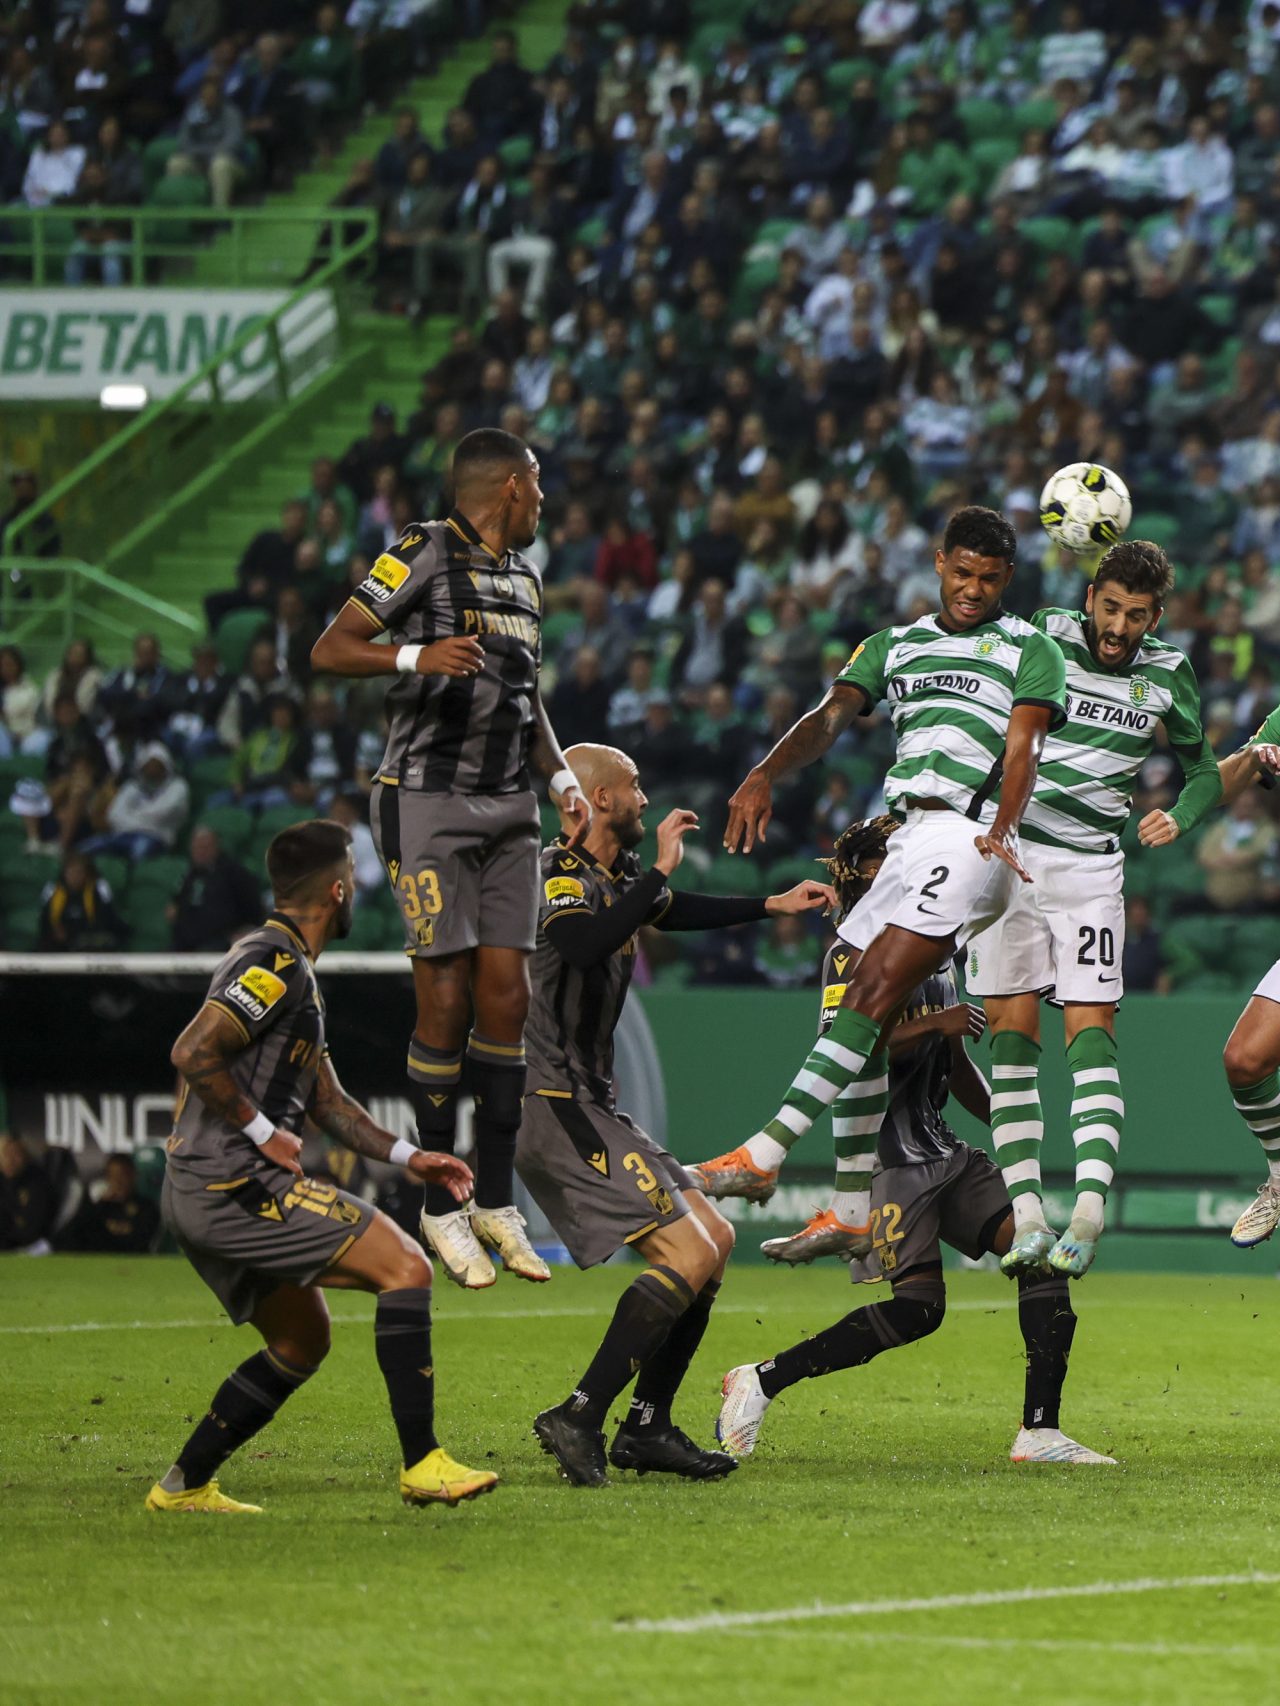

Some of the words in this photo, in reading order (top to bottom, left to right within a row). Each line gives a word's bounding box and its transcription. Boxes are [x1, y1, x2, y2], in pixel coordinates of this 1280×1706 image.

[1075, 700, 1148, 730] BETANO
[400, 870, 443, 918] 33
[920, 866, 949, 900] 2
[1078, 926, 1114, 966] 20
[229, 984, 263, 1016] bwin
[622, 1152, 657, 1192] 3
[870, 1203, 905, 1248] 22
